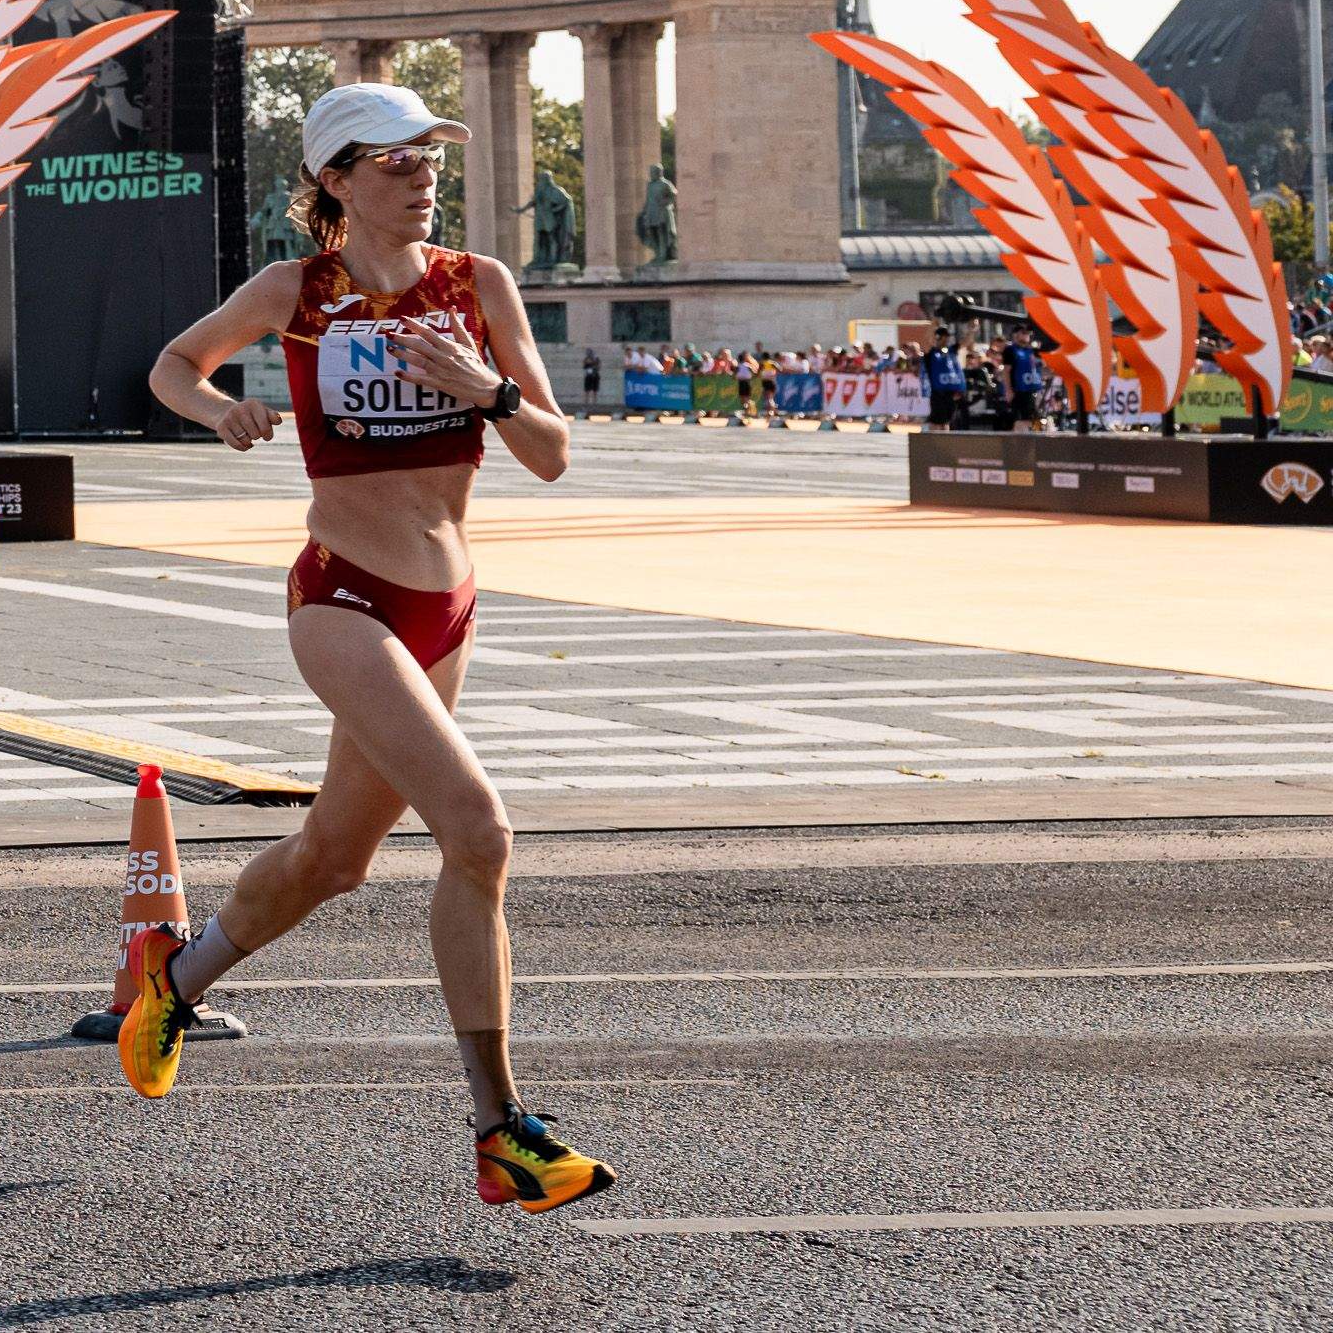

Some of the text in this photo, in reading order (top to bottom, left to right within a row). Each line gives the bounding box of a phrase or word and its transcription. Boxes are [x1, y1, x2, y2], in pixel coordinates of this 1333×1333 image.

[41, 150, 184, 179] WITNESS
[25, 172, 203, 205] THE WONDER
[370, 417, 466, 437] BUDAPEST 23
[6, 504, 22, 514] 23
